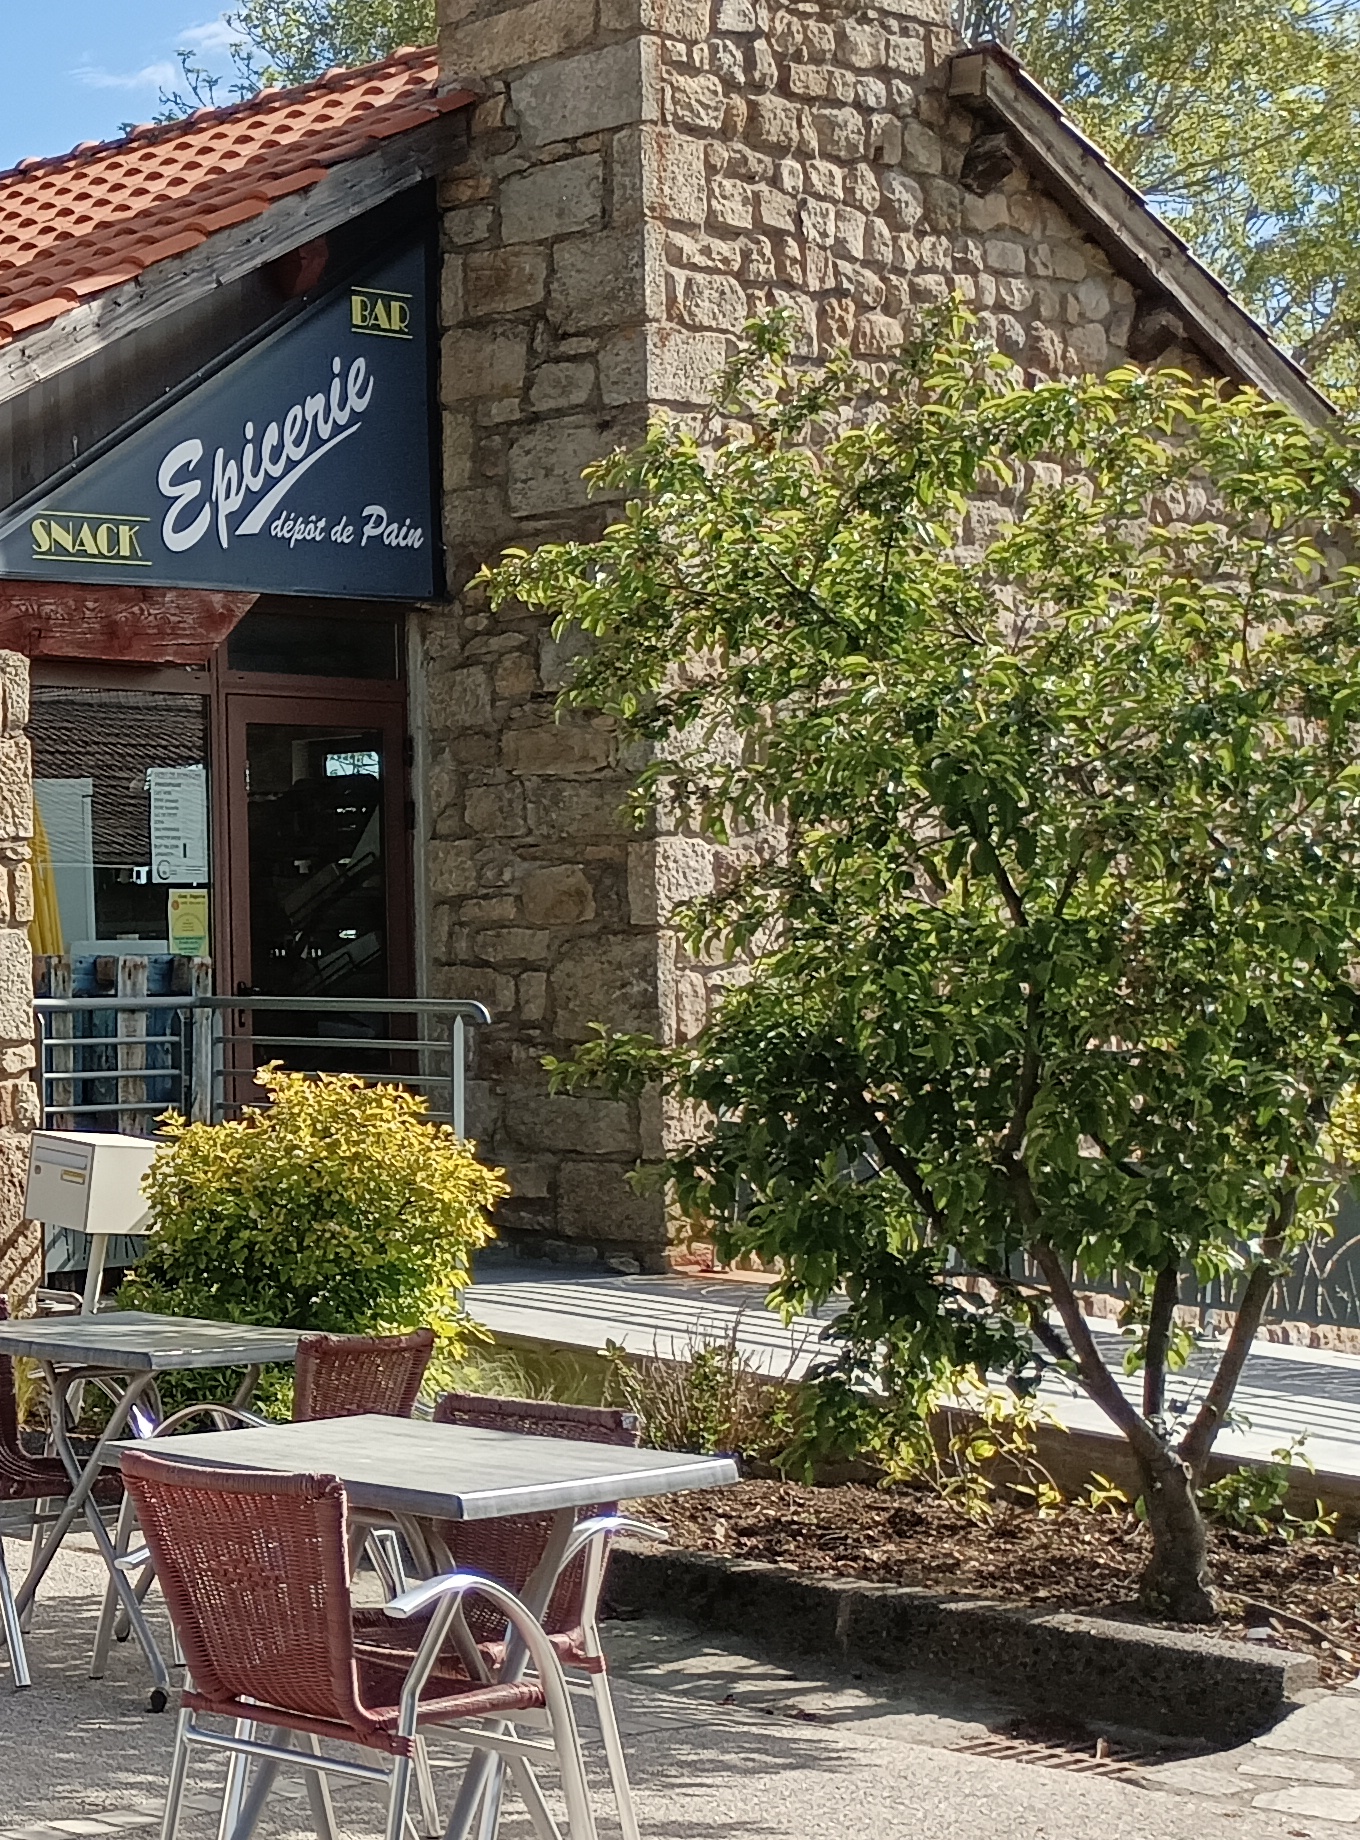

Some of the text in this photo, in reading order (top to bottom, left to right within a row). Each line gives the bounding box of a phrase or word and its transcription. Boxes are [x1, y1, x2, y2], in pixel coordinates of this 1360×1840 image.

[350, 294, 410, 334] BAR
[157, 355, 374, 553] Epicerie
[30, 517, 144, 558] SNACK
[270, 503, 425, 550] dépôt de Pain
